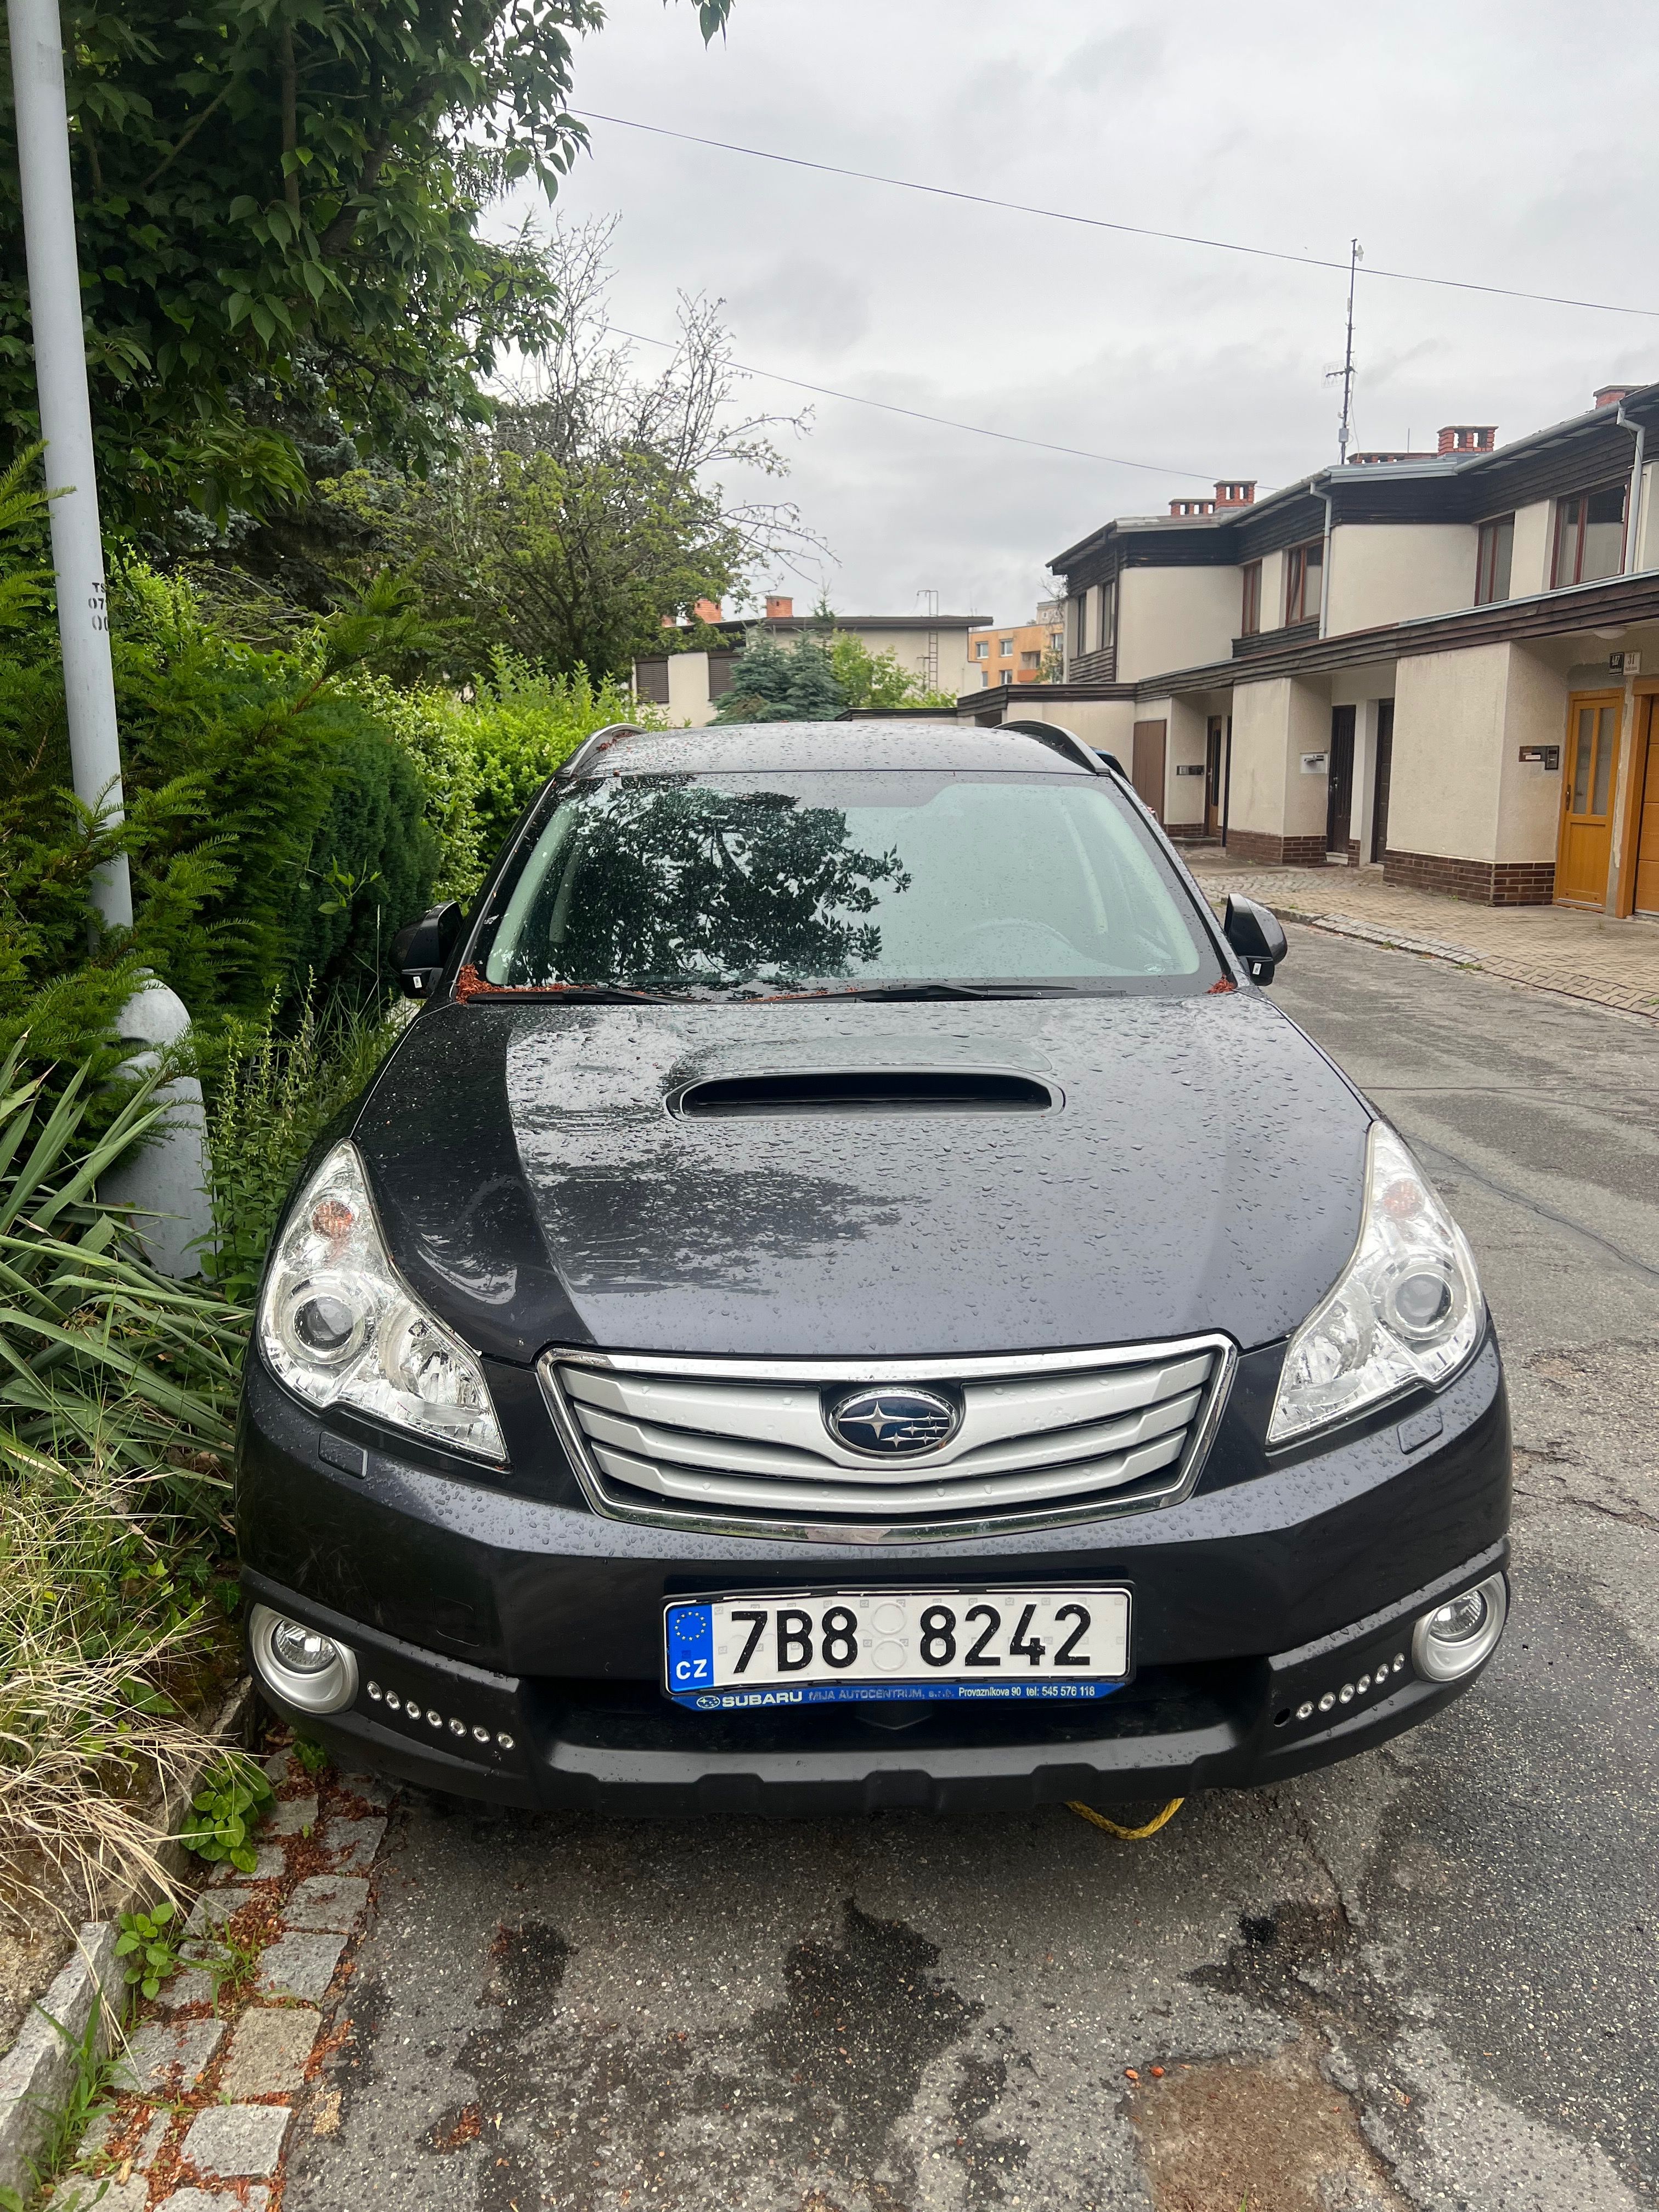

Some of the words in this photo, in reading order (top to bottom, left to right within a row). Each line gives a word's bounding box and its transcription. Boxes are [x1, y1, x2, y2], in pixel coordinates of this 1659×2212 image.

[88, 597, 104, 610] 07
[731, 1606, 858, 1674] 7B8
[920, 1604, 1091, 1667] 8242
[676, 1659, 707, 1680] CZ
[722, 1691, 802, 1707] SUBARU
[1011, 1686, 1022, 1696] 90
[1026, 1686, 1039, 1696] tel:
[1041, 1686, 1058, 1696] 545
[1060, 1686, 1077, 1696] 576
[1080, 1686, 1095, 1696] 118
